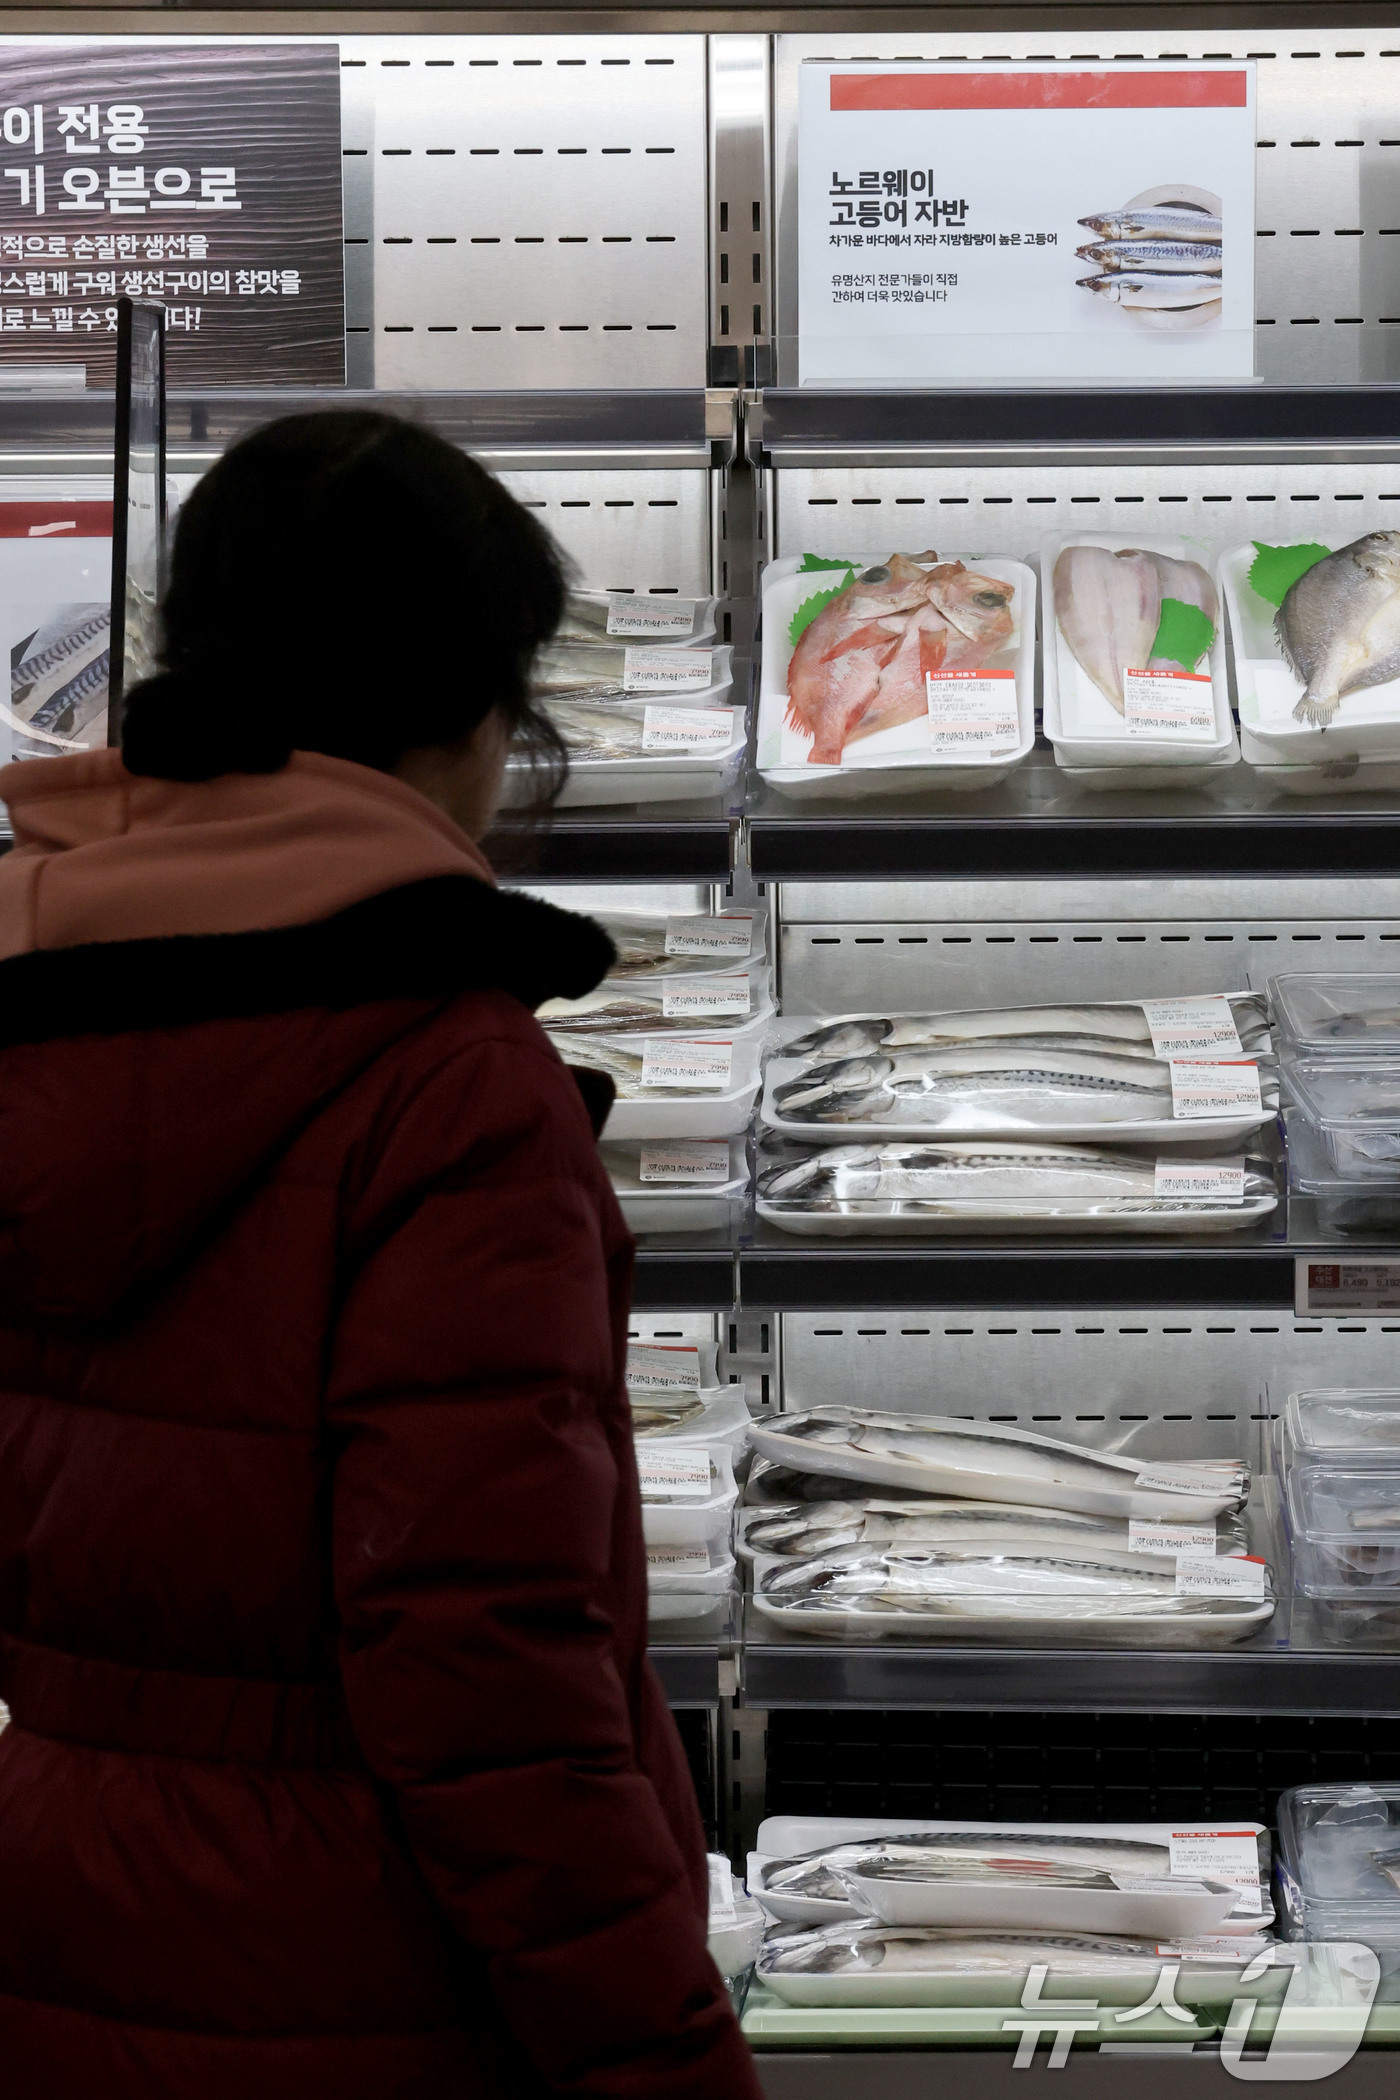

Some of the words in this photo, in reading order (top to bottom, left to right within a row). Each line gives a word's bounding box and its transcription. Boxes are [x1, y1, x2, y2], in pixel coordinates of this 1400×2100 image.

[0, 104, 44, 155] 이
[57, 104, 149, 154] 전용
[58, 165, 242, 214] 오븐으로
[829, 169, 933, 197] 노르웨이
[829, 199, 907, 228] 고등어
[914, 199, 969, 228] 자반
[0, 235, 69, 260] 적으로
[72, 235, 139, 259] 손질한
[142, 234, 209, 259] 생선을
[829, 234, 864, 247] 차가운
[866, 234, 912, 247] 바다에서
[914, 234, 937, 246] 자라
[939, 233, 996, 246] 지방함량이
[999, 233, 1021, 246] 높은
[1023, 233, 1058, 246] 고등어
[0, 270, 68, 296] 스럽게
[73, 270, 116, 296] 구워
[121, 270, 230, 296] 생선구이의
[235, 269, 301, 295] 참맛을
[831, 274, 876, 287] 유명산지
[878, 273, 933, 286] 전문가들이
[935, 273, 958, 286] 직접
[831, 290, 865, 303] 간하여
[867, 290, 890, 302] 더욱
[891, 290, 948, 302] 맛있습니다
[0, 307, 26, 332] 로
[30, 307, 73, 332] 느낄
[78, 307, 101, 332] 수
[1219, 1171, 1241, 1179] 12900
